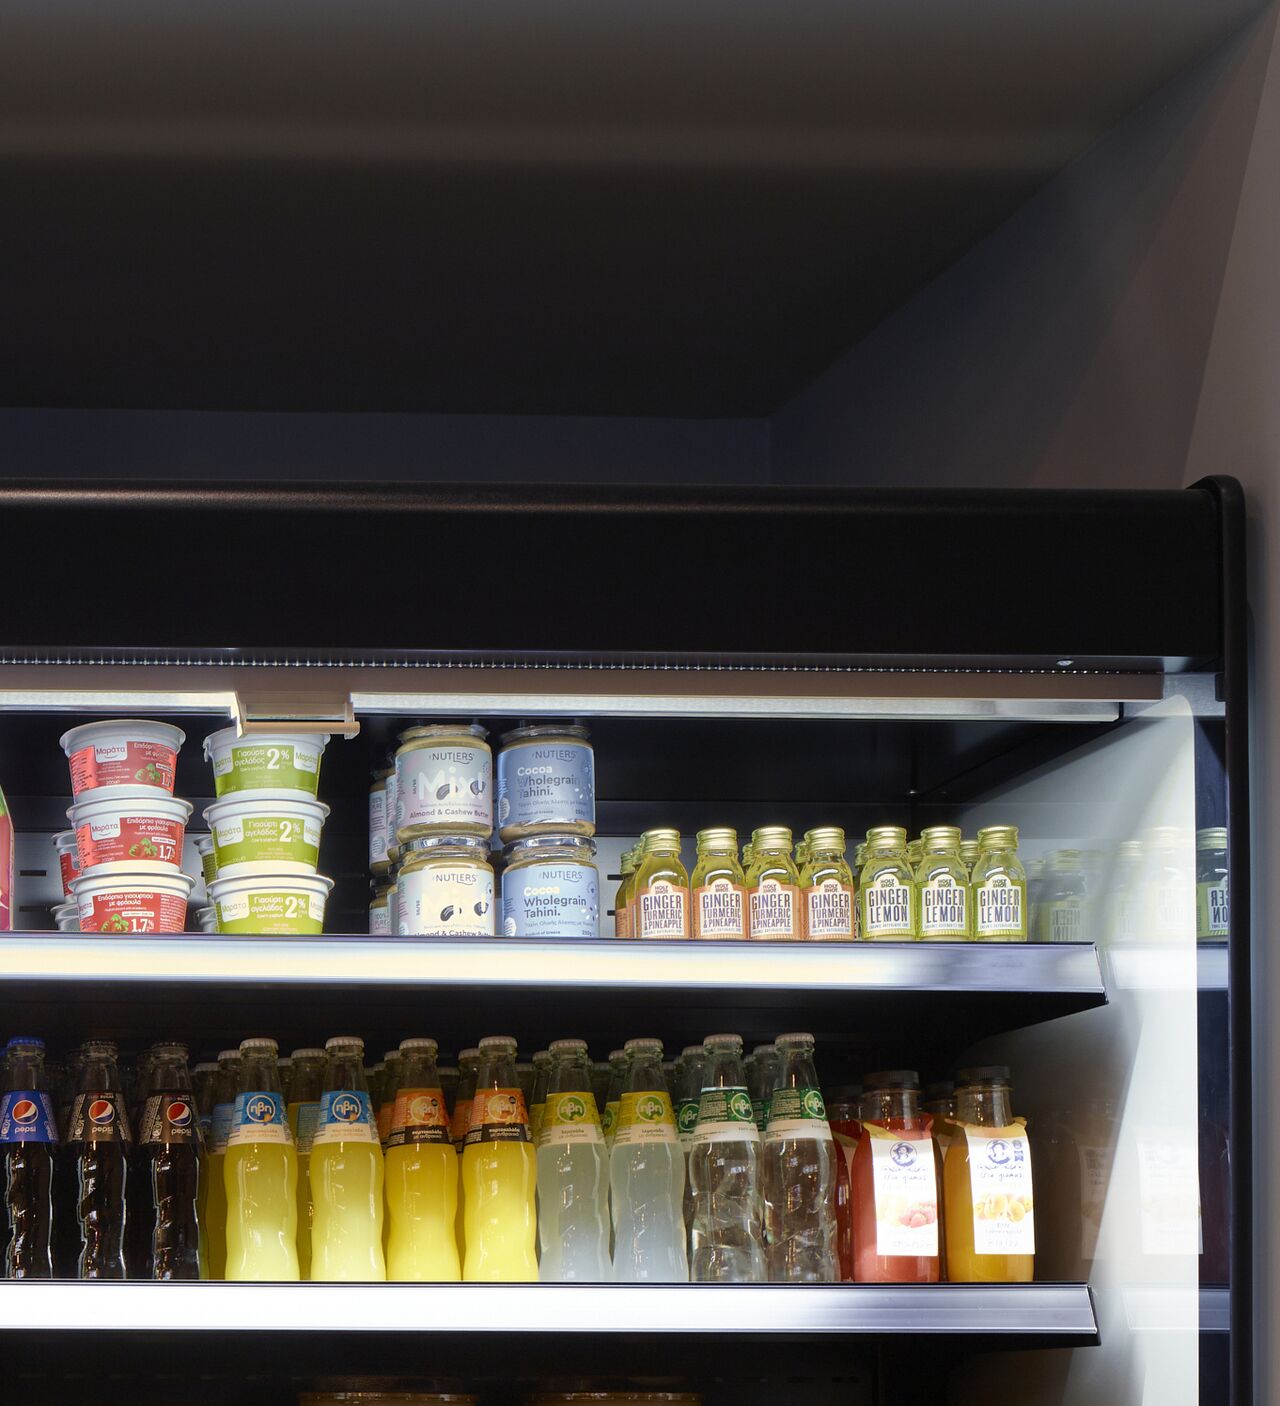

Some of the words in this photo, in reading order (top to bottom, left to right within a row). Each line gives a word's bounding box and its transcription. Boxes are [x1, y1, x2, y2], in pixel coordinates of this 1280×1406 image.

[517, 766, 553, 777] Cocoa
[409, 809, 435, 819] Almond
[444, 808, 473, 816] Cashew
[523, 886, 561, 896] Cocoa
[868, 888, 908, 906] GINGER
[925, 888, 964, 906] GINGER
[980, 888, 1020, 906] GINGER
[523, 896, 587, 908] Wholegrain
[643, 894, 682, 909] GINGER
[702, 893, 741, 909] GINGER
[751, 893, 791, 909] GINGER
[811, 893, 850, 909] GINGER
[643, 908, 682, 921] TURMERIC
[703, 907, 741, 920] TURMERIC
[752, 907, 791, 920] TURMERIC
[811, 907, 850, 920] TURMERIC
[870, 905, 908, 924] LEMON
[926, 906, 963, 923] LEMON
[981, 906, 1019, 923] LEMON
[14, 1125, 37, 1136] pepsi
[91, 1125, 114, 1136] pepsi
[171, 1126, 192, 1137] pepsi
